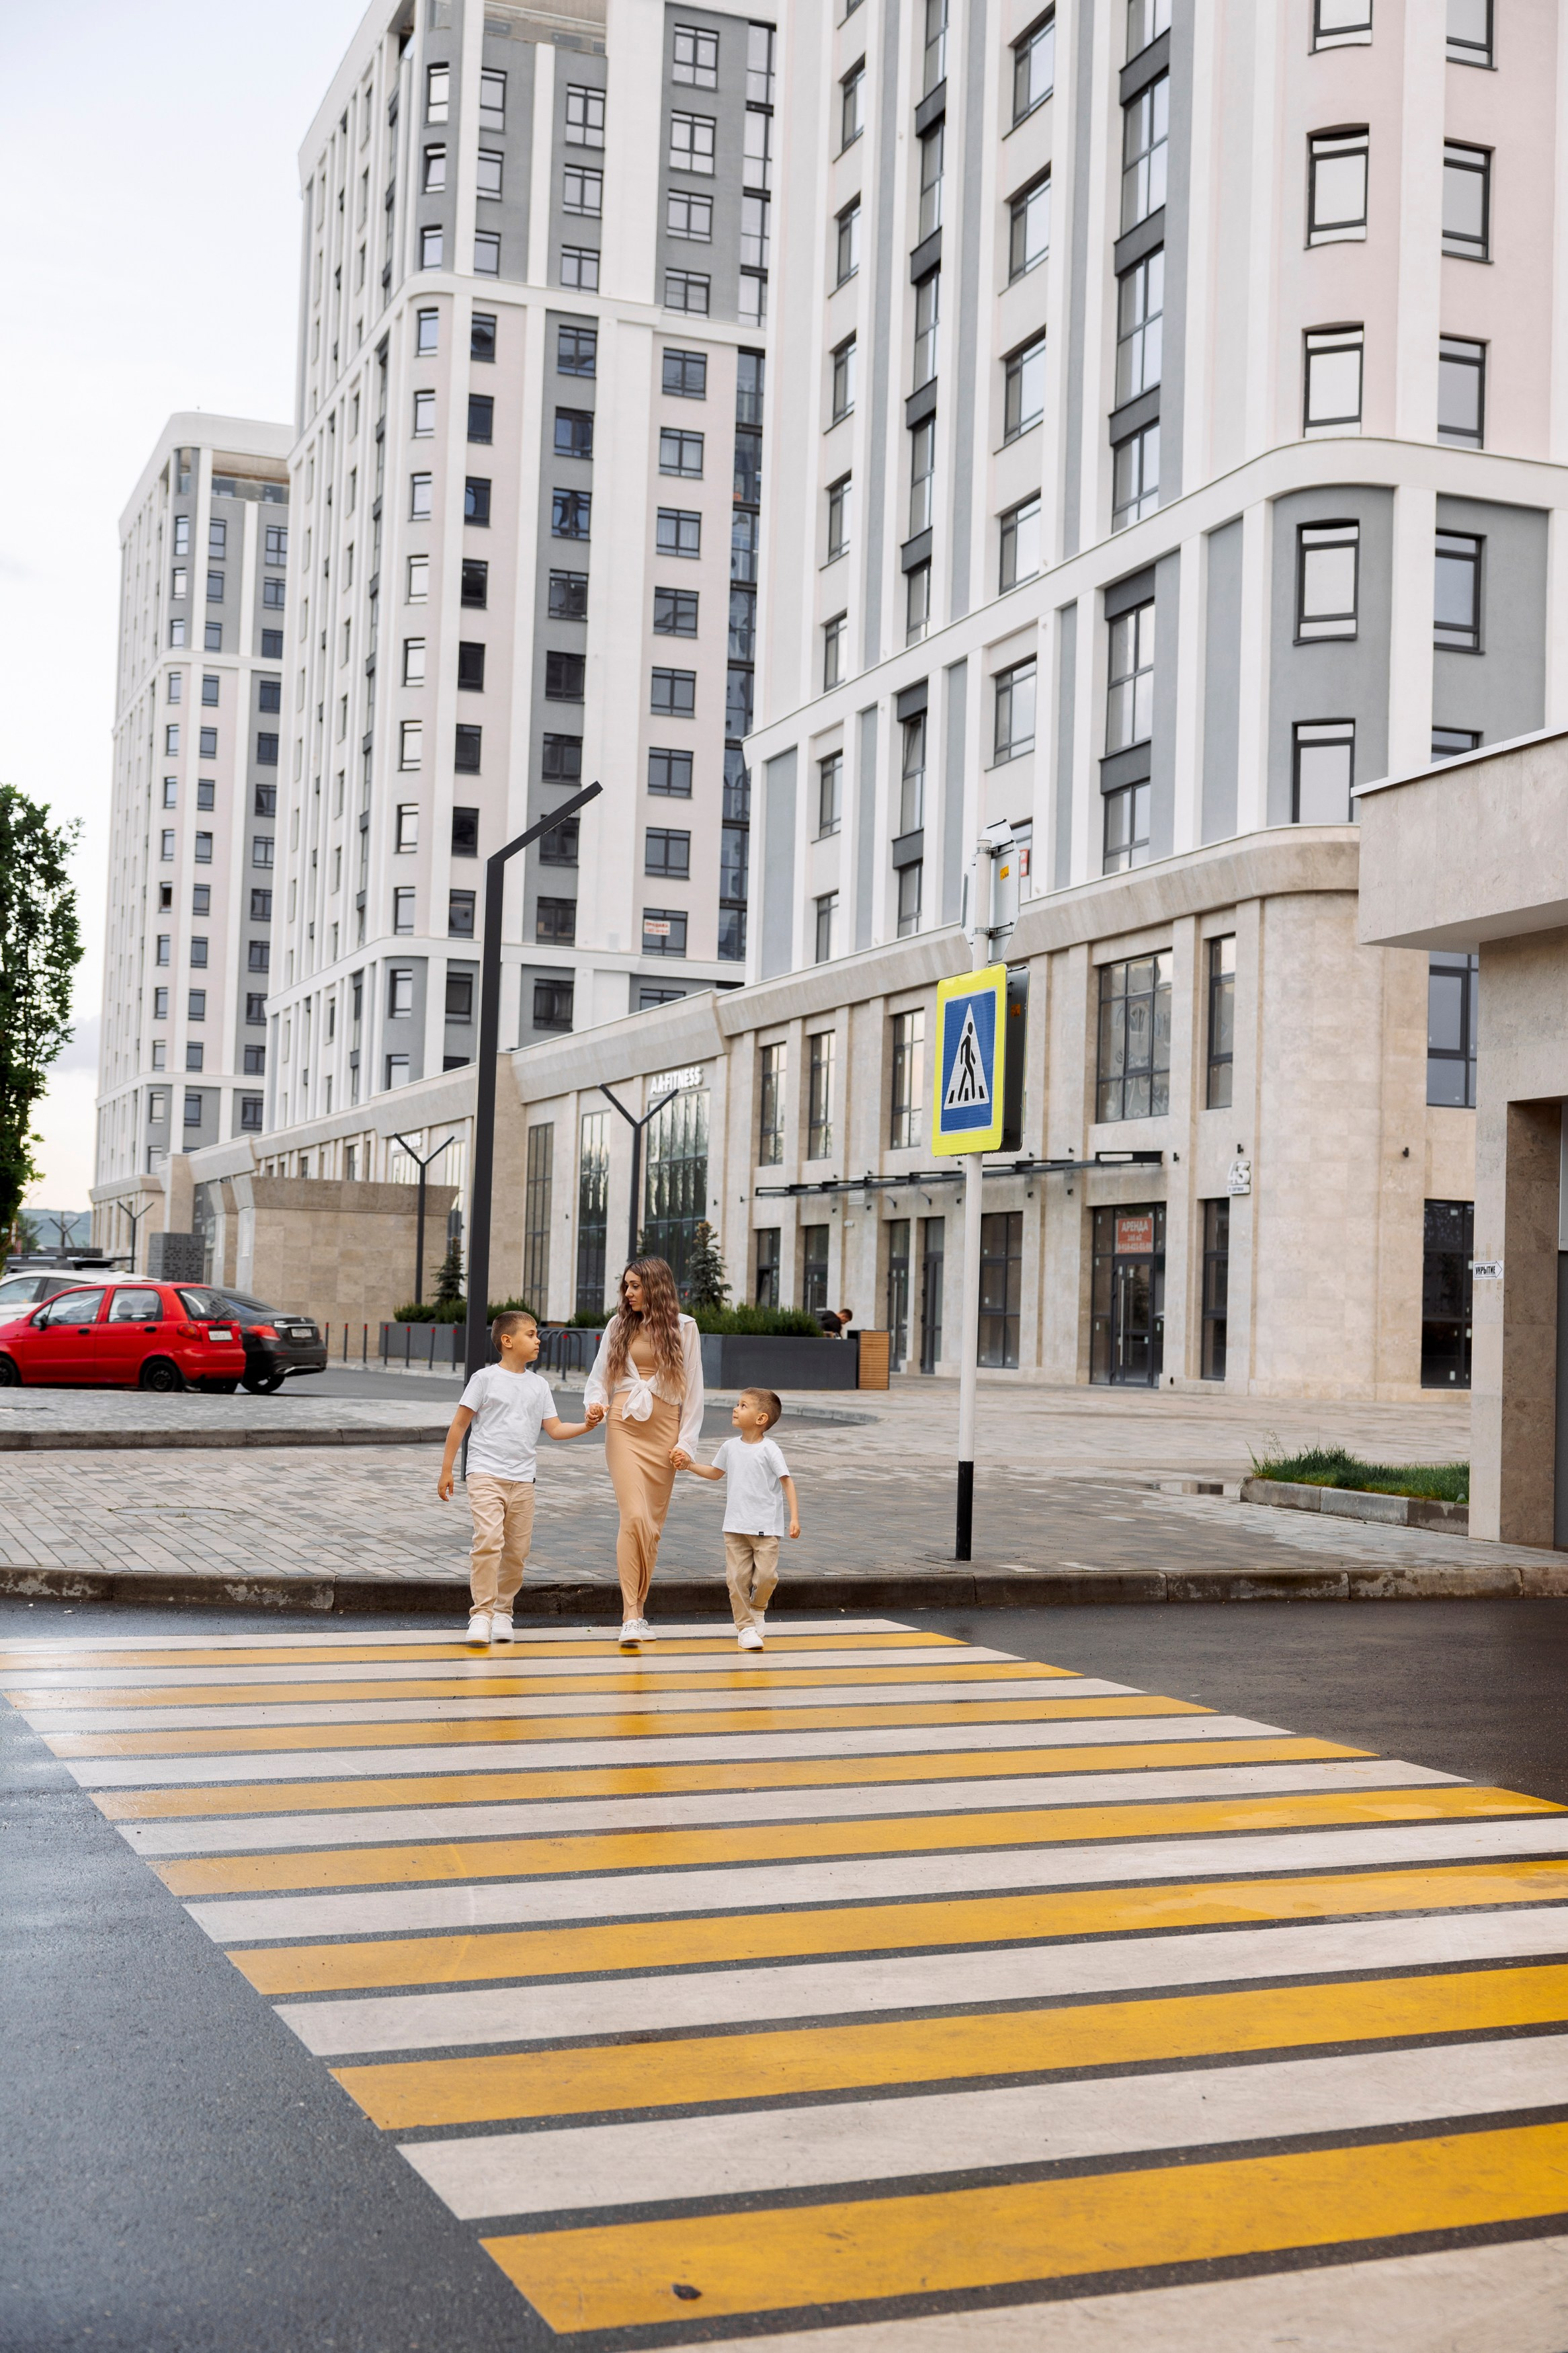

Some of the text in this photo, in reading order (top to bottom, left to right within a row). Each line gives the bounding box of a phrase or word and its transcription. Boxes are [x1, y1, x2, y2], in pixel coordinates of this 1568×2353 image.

[1227, 1160, 1251, 1184] 43
[1121, 1220, 1149, 1233] АРЕНДА
[1475, 1266, 1495, 1275] УКРЫТИЕ
